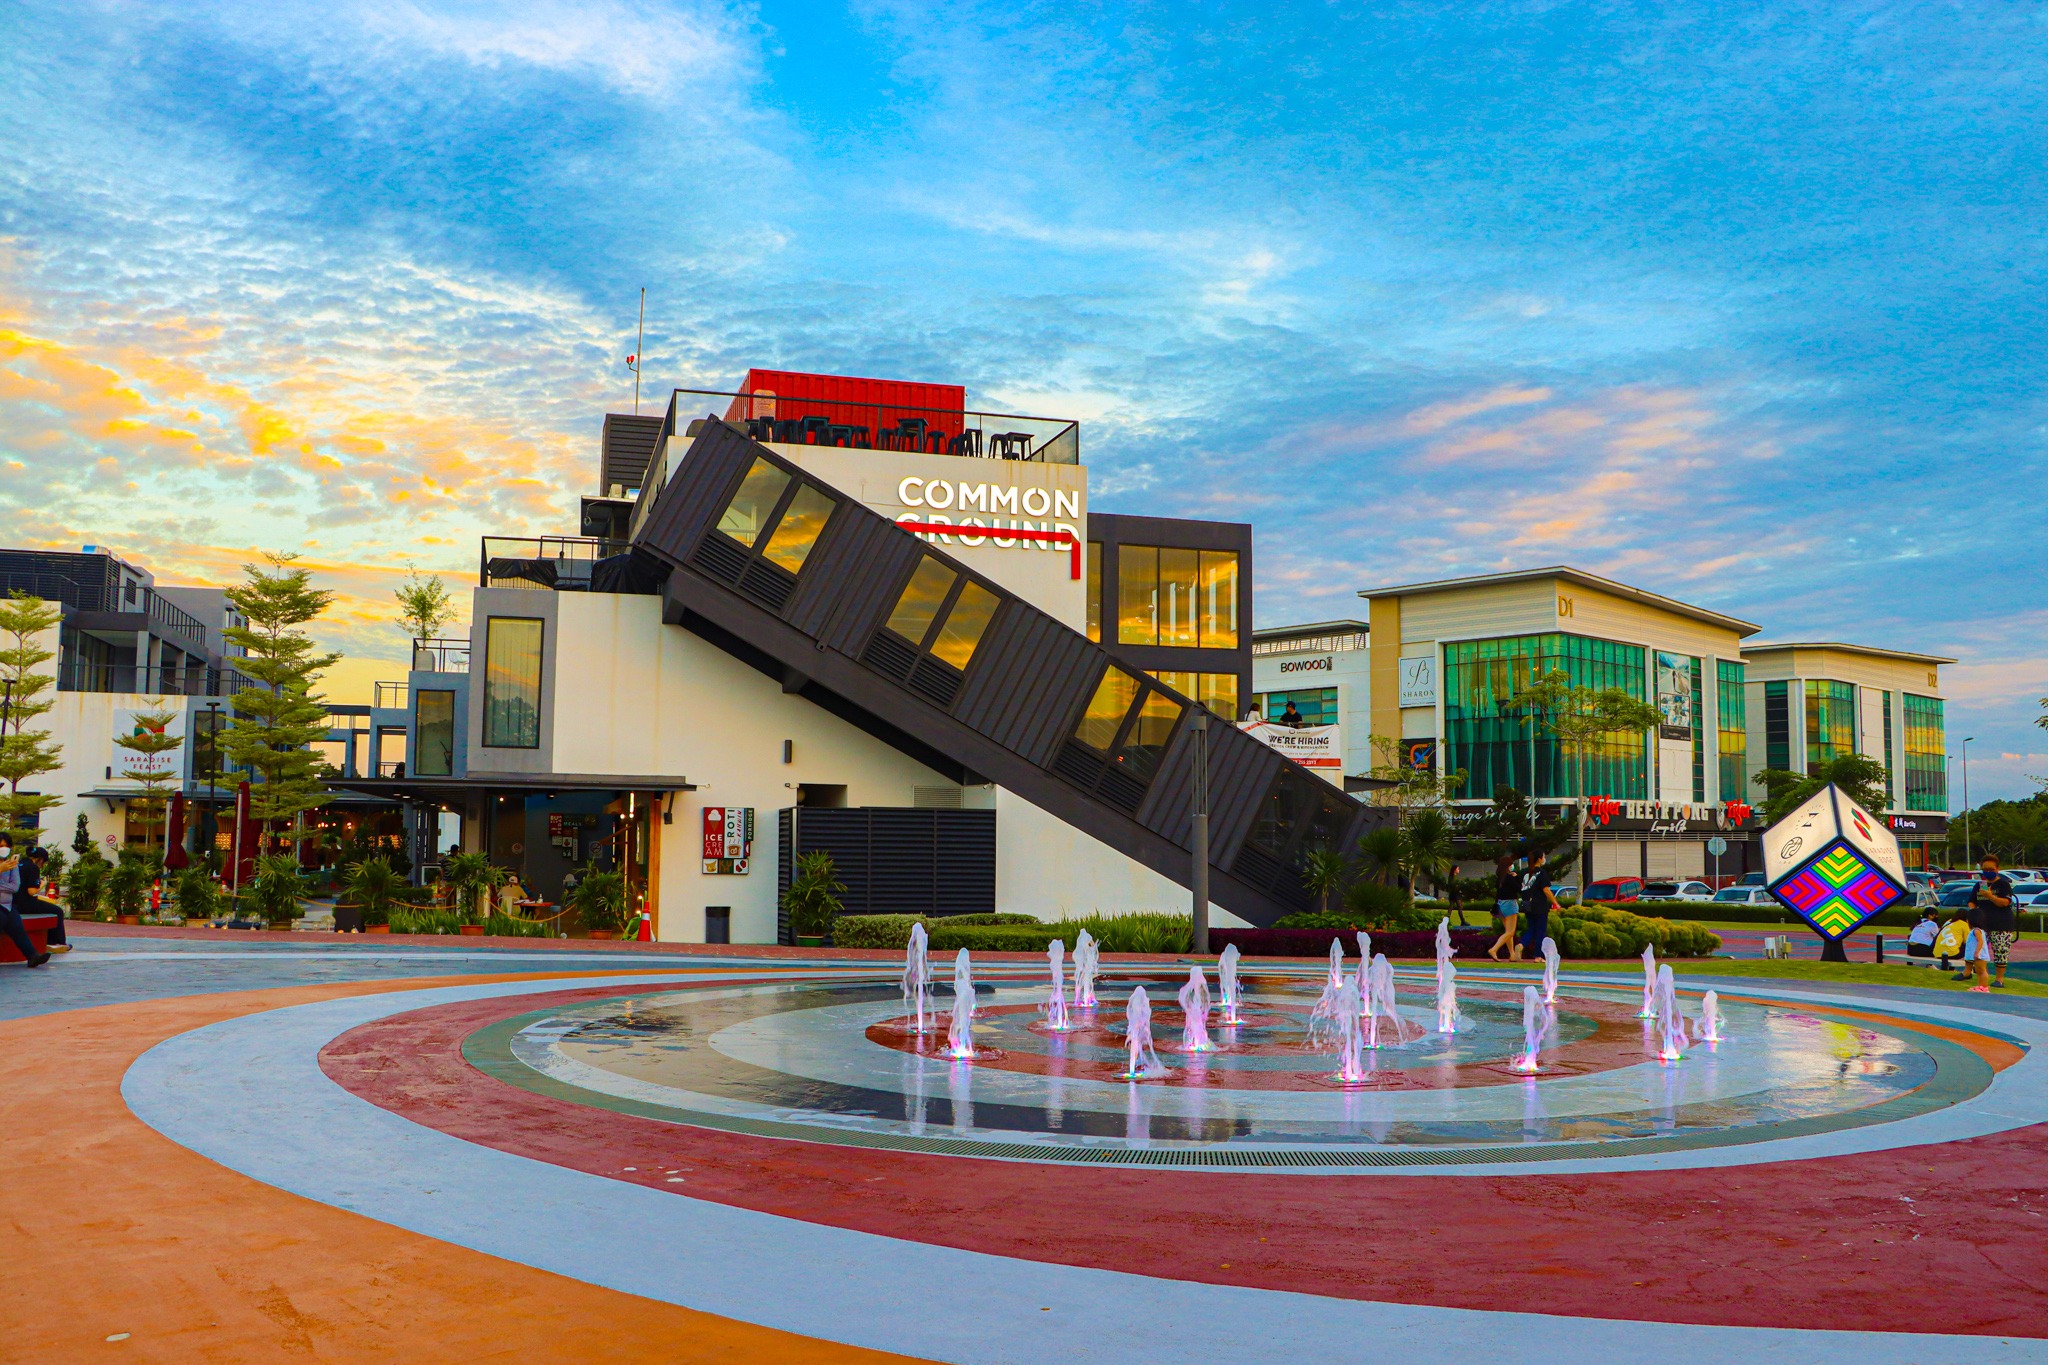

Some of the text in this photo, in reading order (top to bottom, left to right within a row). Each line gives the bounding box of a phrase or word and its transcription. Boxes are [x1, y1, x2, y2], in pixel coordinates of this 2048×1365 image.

[898, 476, 1079, 519] COMMON
[895, 512, 1080, 551] GROUND
[1558, 595, 1573, 618] D1
[1280, 659, 1327, 673] BOWOOD
[1927, 672, 1938, 688] D2
[1403, 690, 1435, 698] SHARON
[1268, 735, 1329, 745] WE'RE HIRING
[1589, 794, 1621, 825] Tiger
[1725, 798, 1752, 827] Tiger
[727, 810, 735, 837] ROTI
[705, 848, 723, 856] AM
